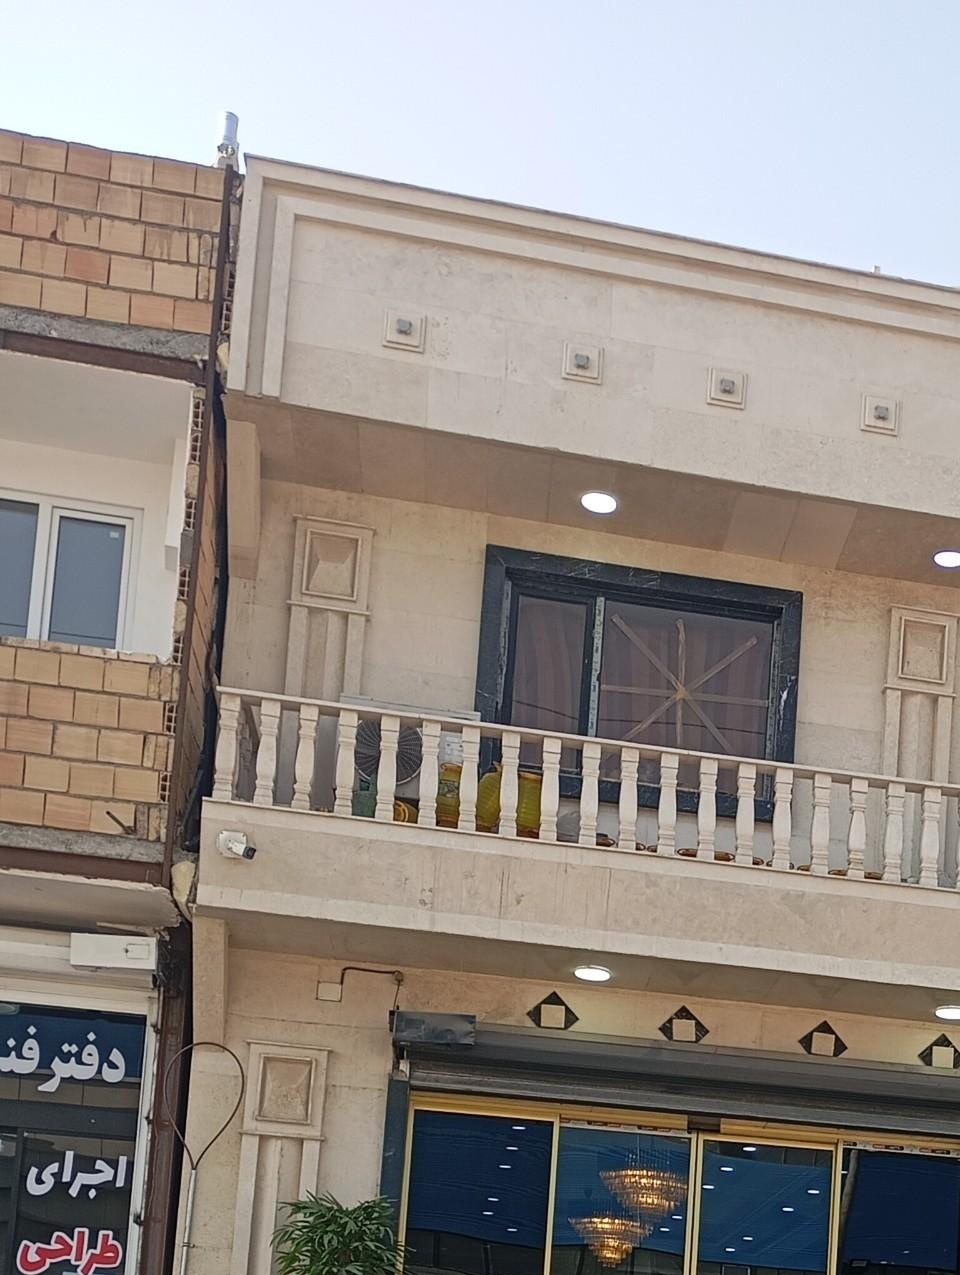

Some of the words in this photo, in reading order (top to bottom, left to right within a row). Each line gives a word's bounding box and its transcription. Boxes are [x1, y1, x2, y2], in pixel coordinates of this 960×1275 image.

[0, 1025, 40, 1074] فن
[38, 1031, 125, 1092] دفتر
[26, 1150, 127, 1199] اجرای
